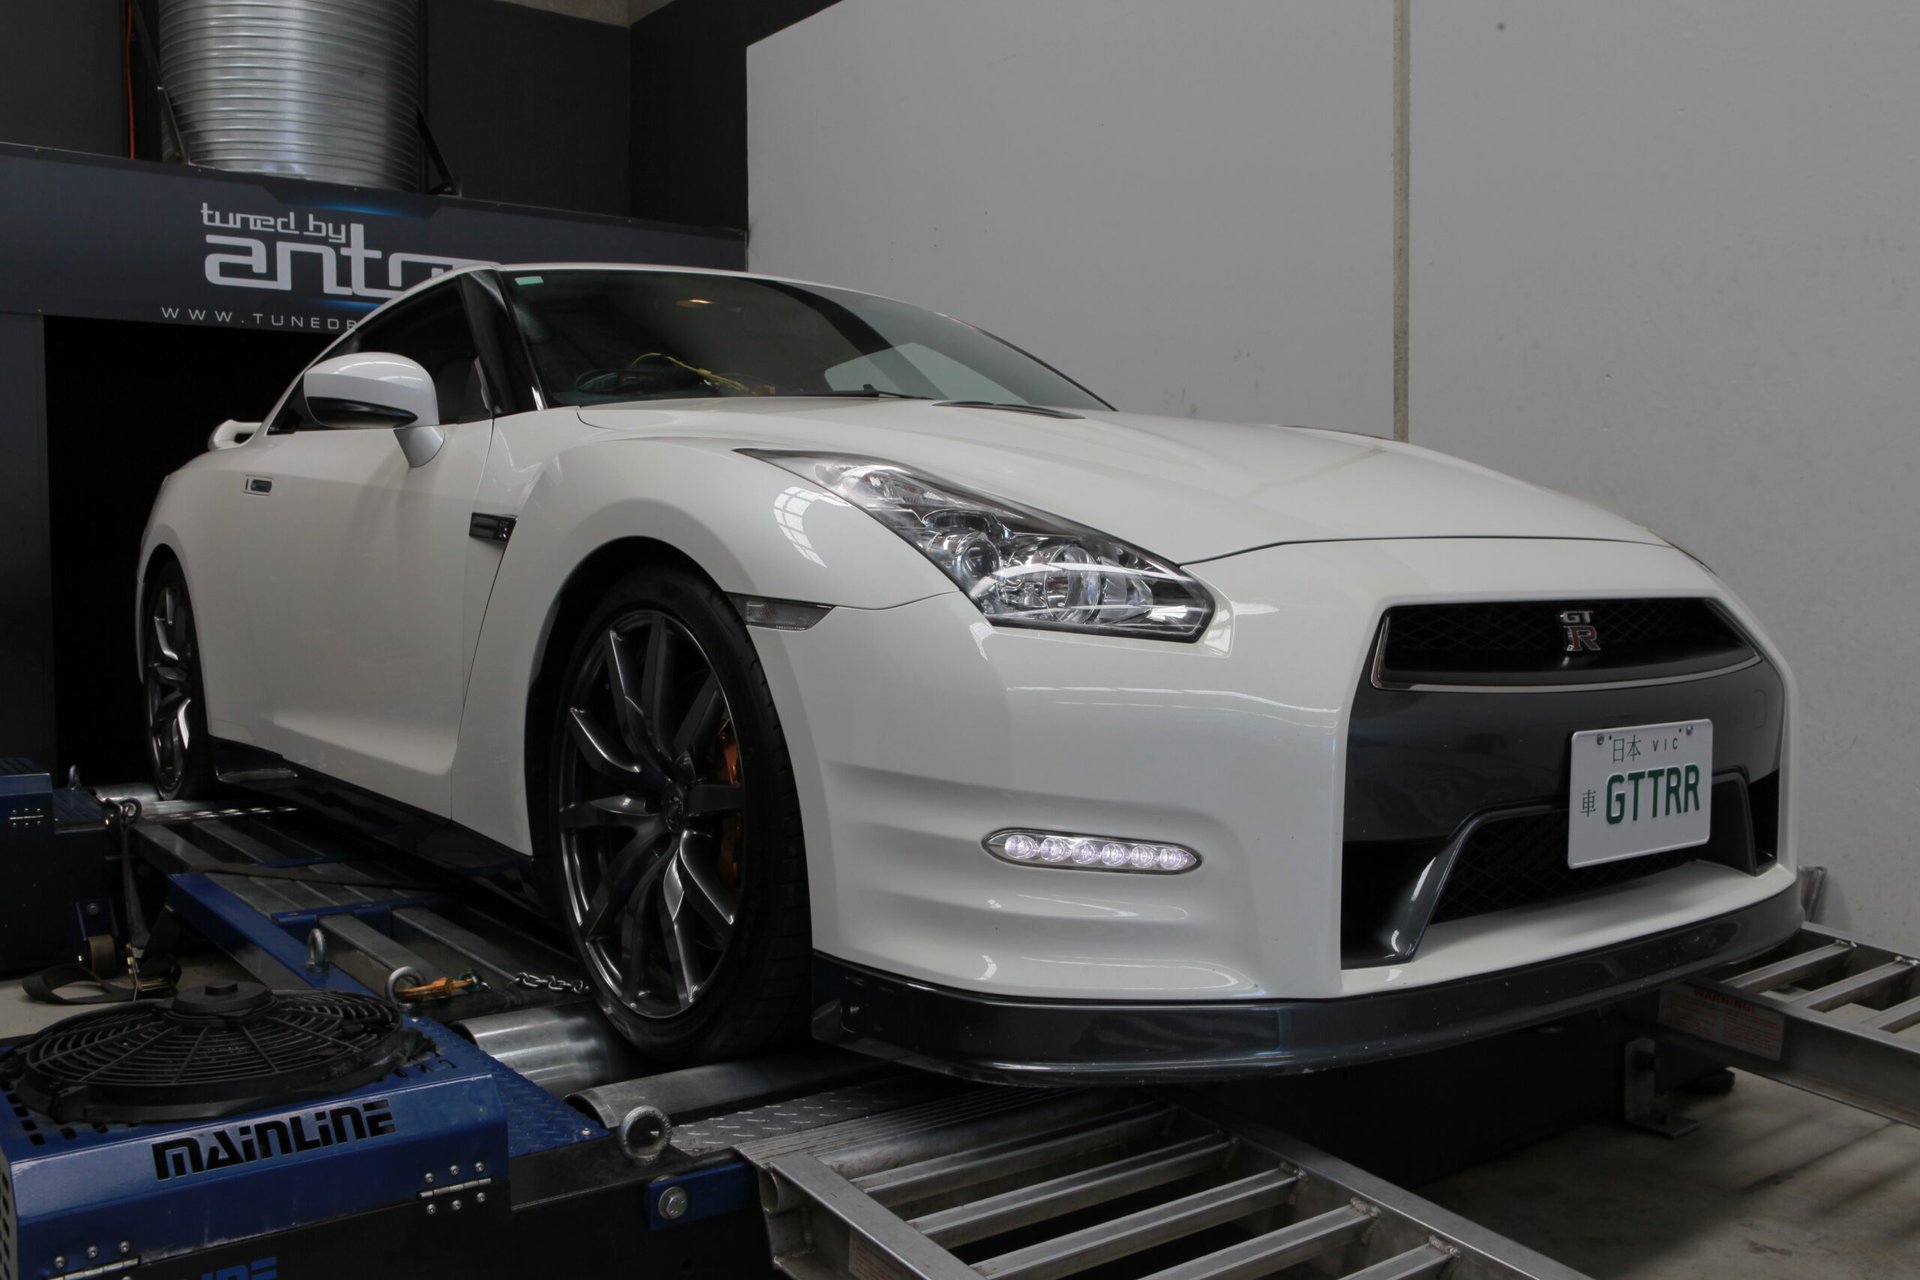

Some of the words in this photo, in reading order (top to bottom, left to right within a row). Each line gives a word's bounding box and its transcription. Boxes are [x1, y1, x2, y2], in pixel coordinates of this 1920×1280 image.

[200, 202, 299, 235] tuned
[303, 213, 347, 244] by
[204, 223, 498, 298] anto
[1560, 610, 1594, 623] GT
[1563, 624, 1601, 652] R
[1612, 735, 1642, 764] 日本
[1652, 737, 1679, 752] VIC
[1580, 789, 1597, 818] 車
[1606, 764, 1700, 825] GTTRR
